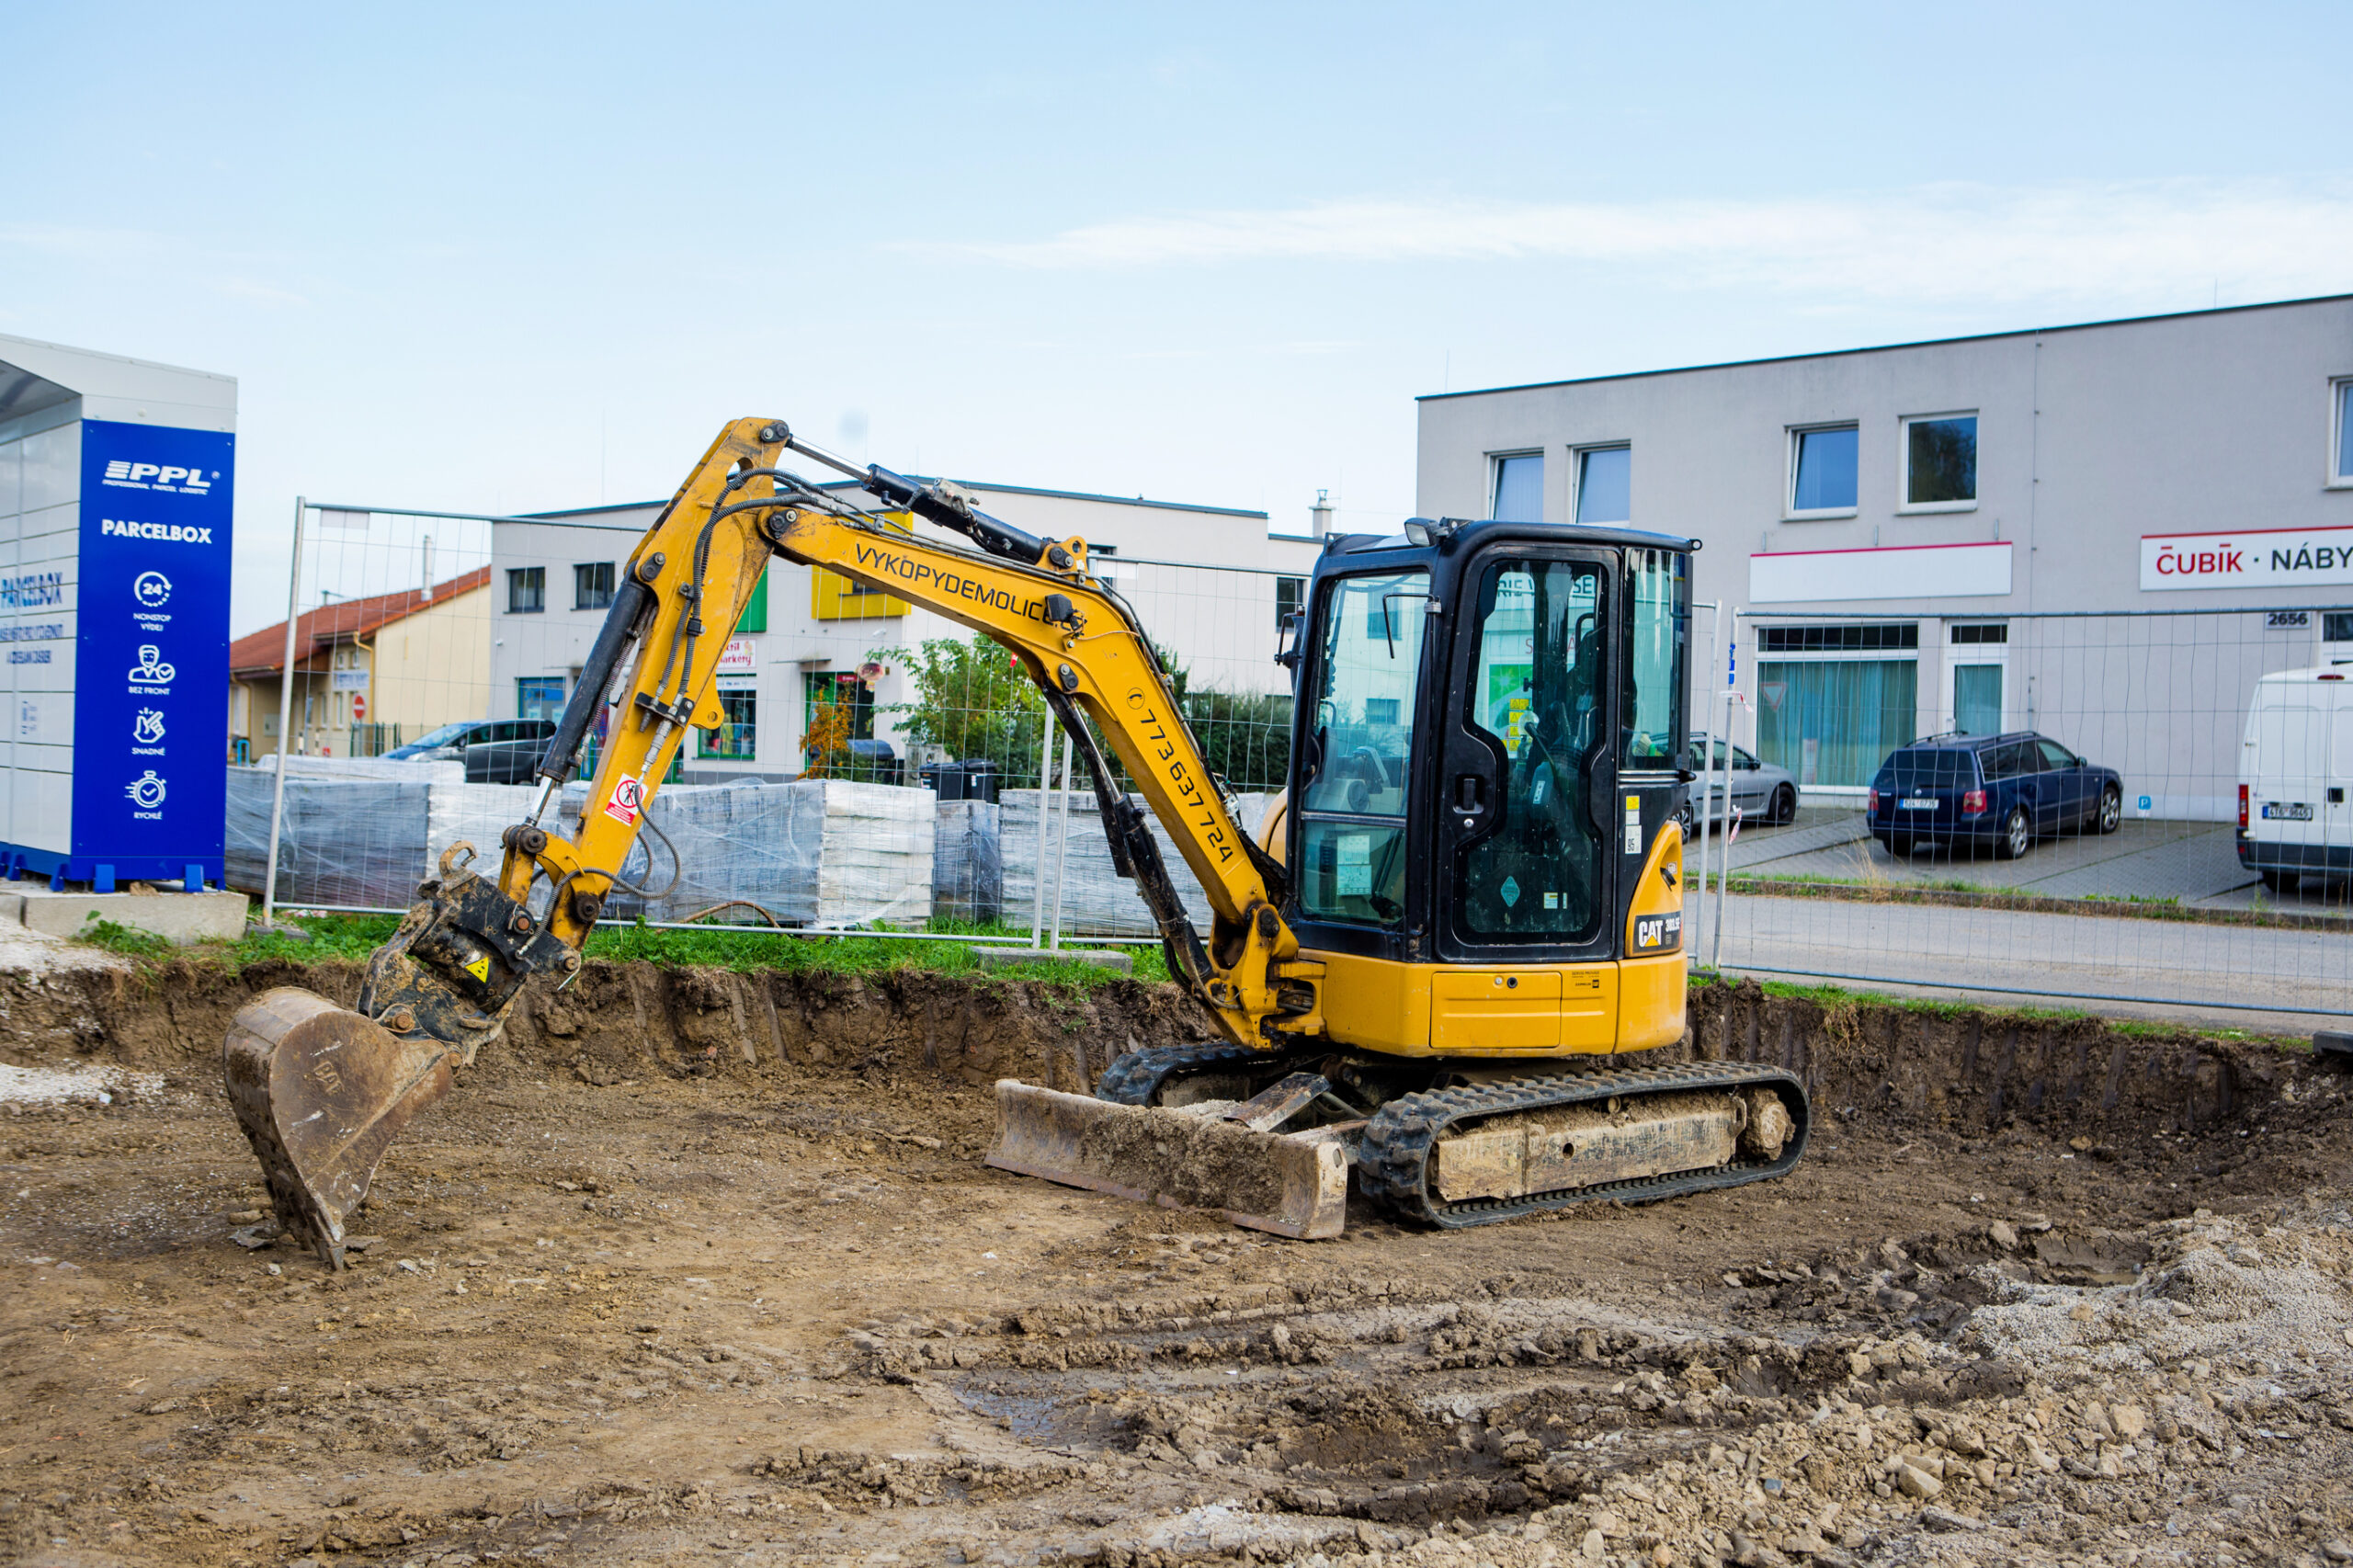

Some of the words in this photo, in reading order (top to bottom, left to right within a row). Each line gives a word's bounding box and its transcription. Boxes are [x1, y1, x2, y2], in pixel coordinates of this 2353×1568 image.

[128, 461, 211, 488] PPL
[101, 517, 212, 545] PARCELBOX
[142, 582, 163, 596] 24
[132, 612, 172, 622] NONSTOP
[2268, 612, 2309, 626] 2656
[128, 686, 143, 695] BEZ
[144, 687, 171, 697] FRONT
[131, 746, 165, 756] SNADNÉ
[1140, 708, 1176, 761] 773
[1169, 760, 1204, 808] 637
[1199, 811, 1234, 863] 724
[133, 810, 163, 821] RYCHLÉ
[1638, 919, 1664, 948] CAT
